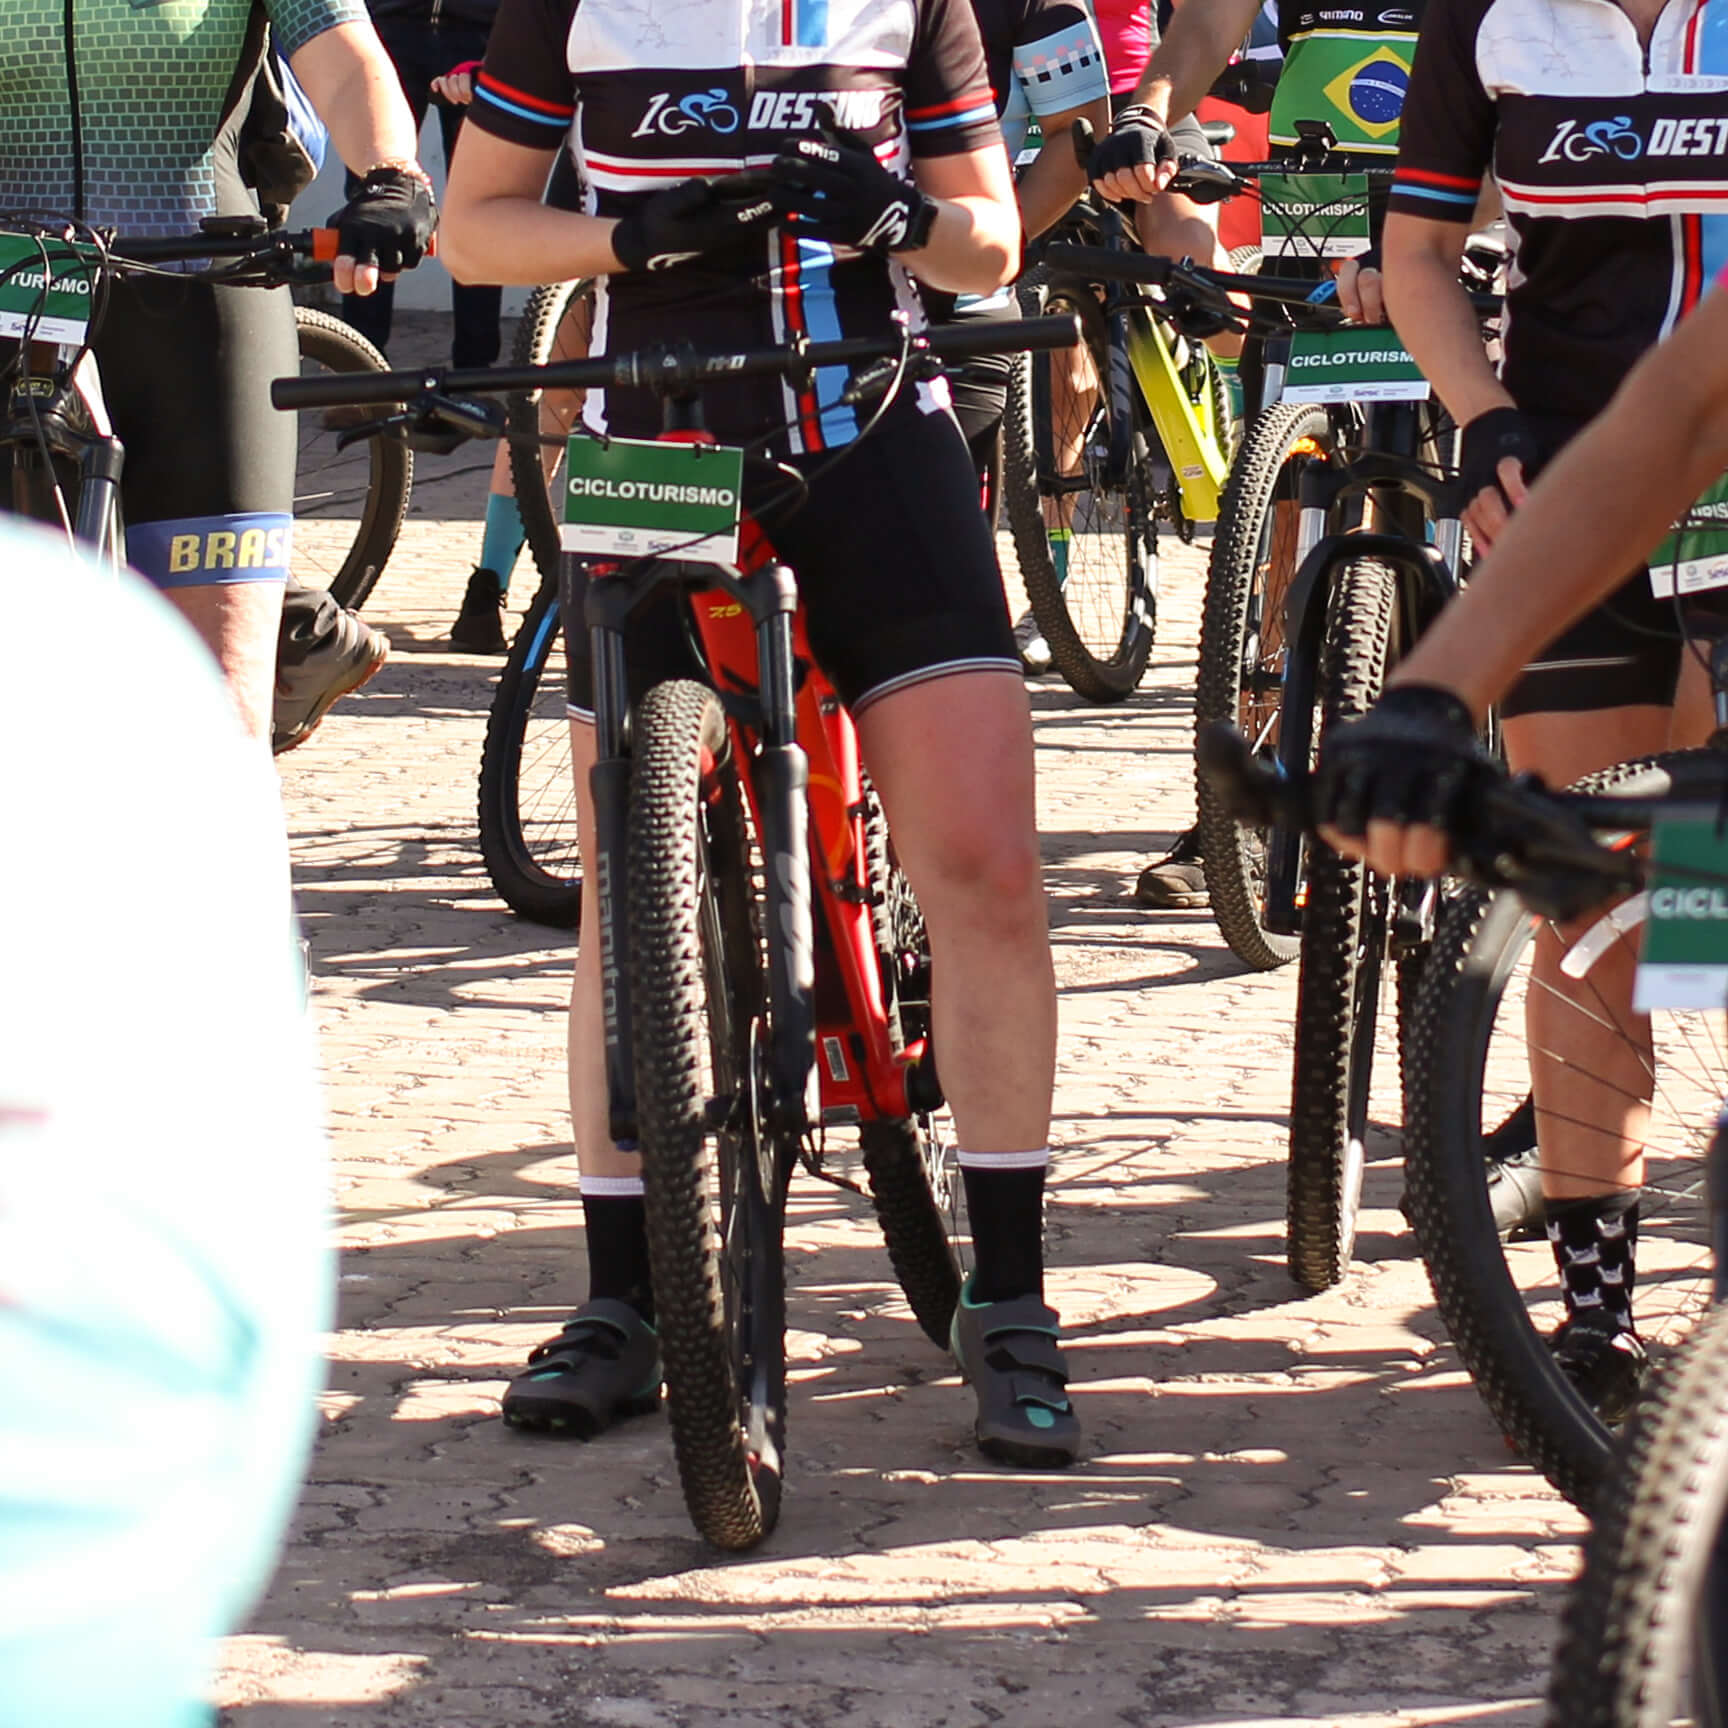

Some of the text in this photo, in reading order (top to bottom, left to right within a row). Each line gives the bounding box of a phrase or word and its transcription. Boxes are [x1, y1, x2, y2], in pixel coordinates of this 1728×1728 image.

[1291, 351, 1415, 368] CICLOTURISM
[569, 477, 735, 507] CICLOTURISMO
[169, 527, 291, 573] BRAS
